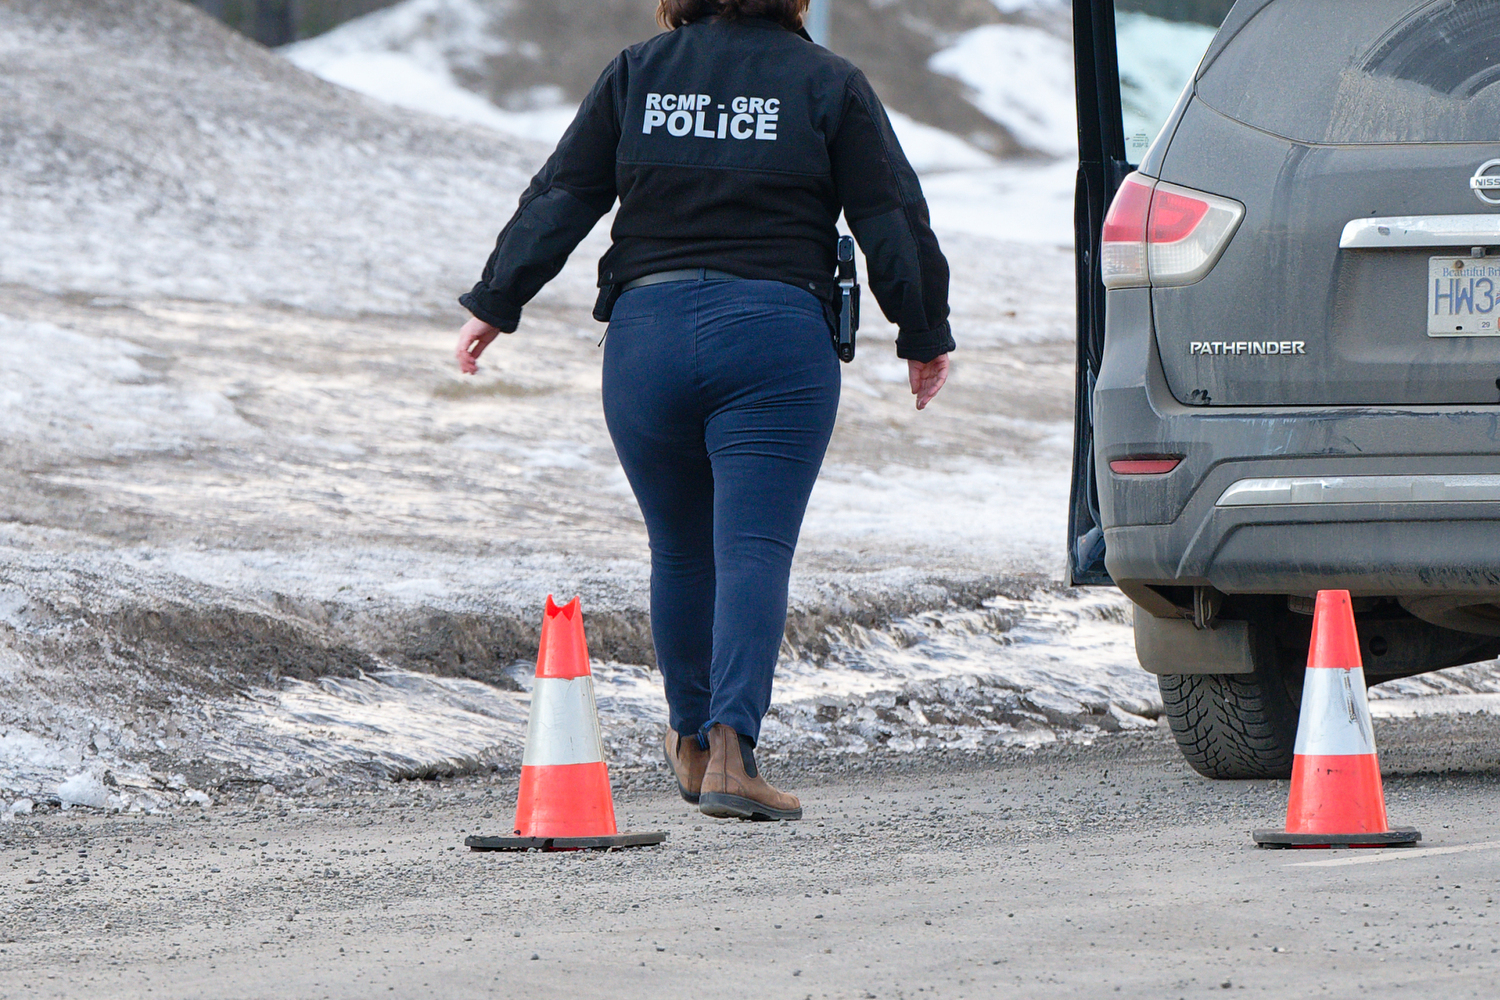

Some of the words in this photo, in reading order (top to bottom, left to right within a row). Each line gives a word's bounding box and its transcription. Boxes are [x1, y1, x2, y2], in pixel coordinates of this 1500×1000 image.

[645, 93, 712, 111] RCMP
[731, 96, 781, 114] GRC
[642, 110, 779, 140] POLICE
[1442, 266, 1486, 277] Beautiful
[1434, 277, 1495, 315] HW3
[1190, 341, 1306, 354] PATHFINDER
